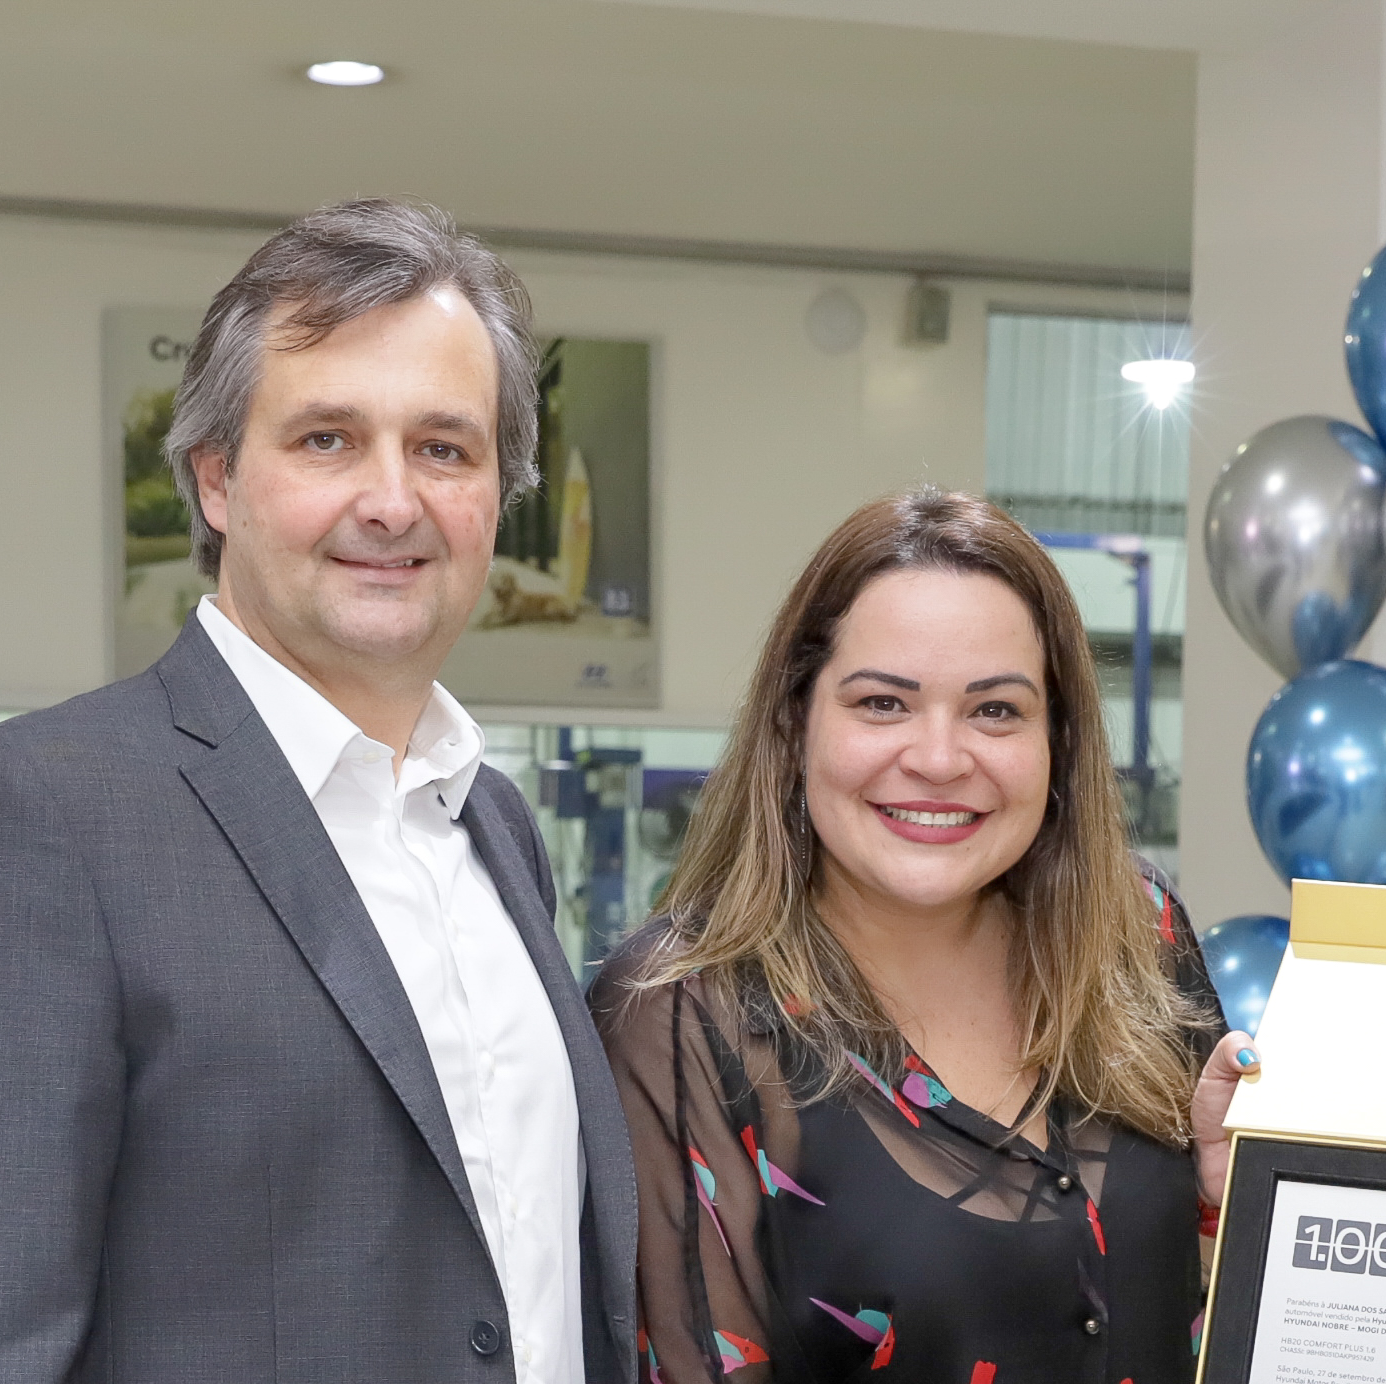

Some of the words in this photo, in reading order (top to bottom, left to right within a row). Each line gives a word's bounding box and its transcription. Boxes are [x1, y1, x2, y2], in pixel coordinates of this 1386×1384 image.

[1286, 1297, 1319, 1309] Parabéns
[1326, 1302, 1360, 1312] JULIANA
[1361, 1305, 1377, 1314] DOS
[1284, 1308, 1323, 1319] automóvel
[1324, 1312, 1354, 1321] vendido
[1354, 1315, 1371, 1324] pela
[1283, 1317, 1320, 1327] HYUNDAI
[1321, 1321, 1349, 1331] NOBRE
[1357, 1325, 1379, 1334] MOGI
[1281, 1337, 1302, 1346] HB20
[1303, 1339, 1343, 1351] COMFORT
[1344, 1343, 1364, 1353] PLUS
[1366, 1346, 1376, 1354] 1.6
[1275, 1374, 1306, 1384] Hyundai
[1276, 1364, 1291, 1373] São
[1292, 1366, 1316, 1377] Paulo,
[1317, 1369, 1326, 1377] 27
[1327, 1370, 1337, 1378] de
[1339, 1372, 1375, 1383] setembro
[1376, 1376, 1386, 1384] de
